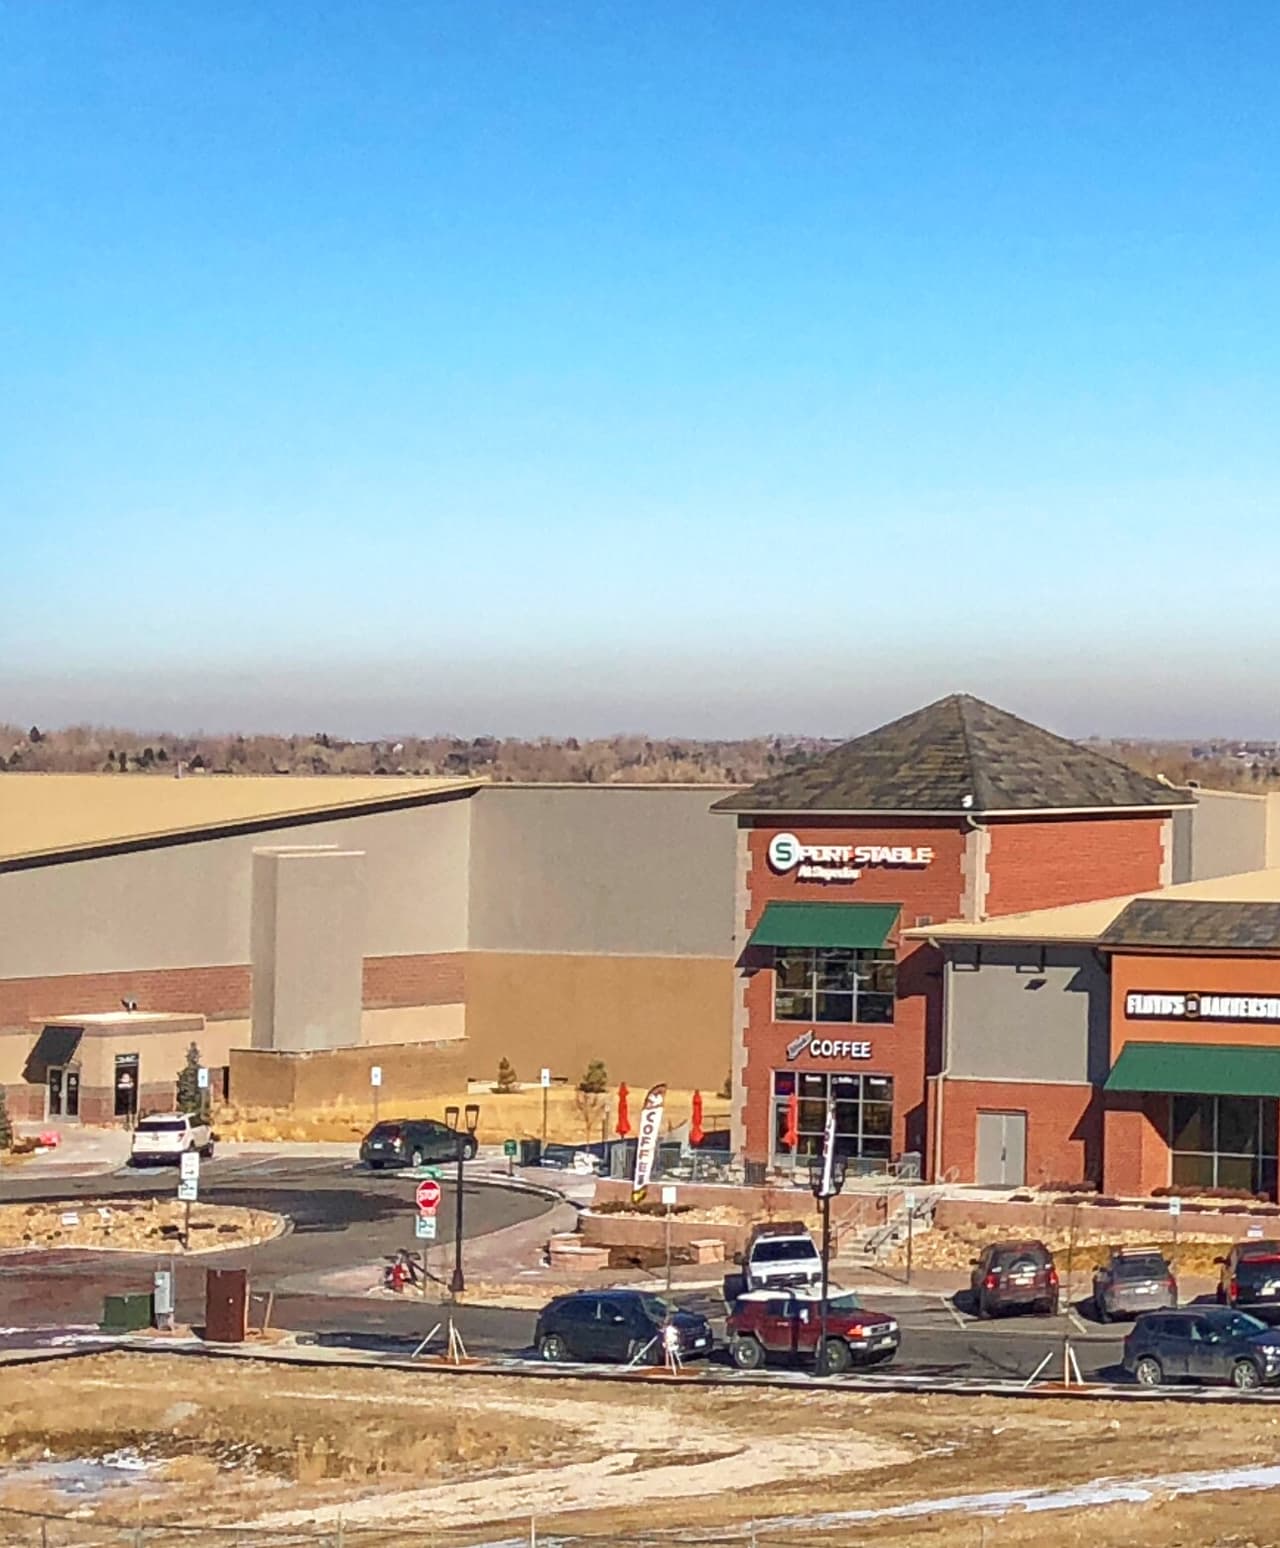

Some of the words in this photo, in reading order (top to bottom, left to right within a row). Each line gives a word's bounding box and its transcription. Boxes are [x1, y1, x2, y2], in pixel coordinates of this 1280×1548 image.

[775, 842, 853, 863] SPORT
[854, 846, 933, 864] STABLE
[811, 1039, 871, 1058] COFFEE
[638, 1111, 656, 1186] COFFEE
[418, 1188, 440, 1201] STOP
